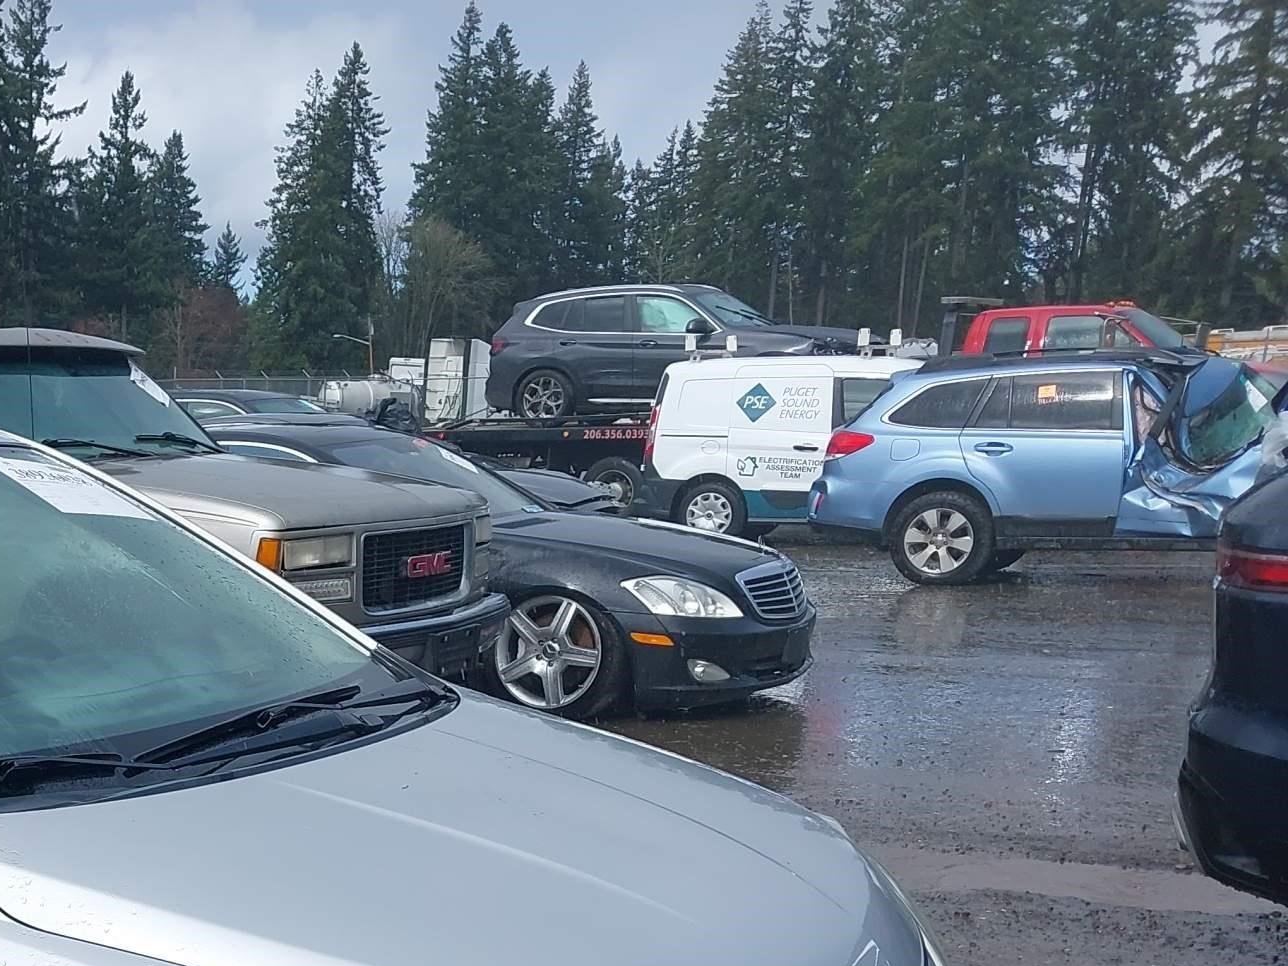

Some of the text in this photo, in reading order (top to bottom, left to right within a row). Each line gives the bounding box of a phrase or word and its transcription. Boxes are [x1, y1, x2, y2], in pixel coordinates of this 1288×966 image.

[782, 387, 818, 397] PUGET
[743, 395, 769, 409] PSE
[780, 398, 820, 408] SOUND
[779, 409, 820, 419] ENERGY
[765, 464, 817, 473] ASSESSMENT
[779, 471, 801, 479] TEAM
[408, 550, 452, 578] GMC
